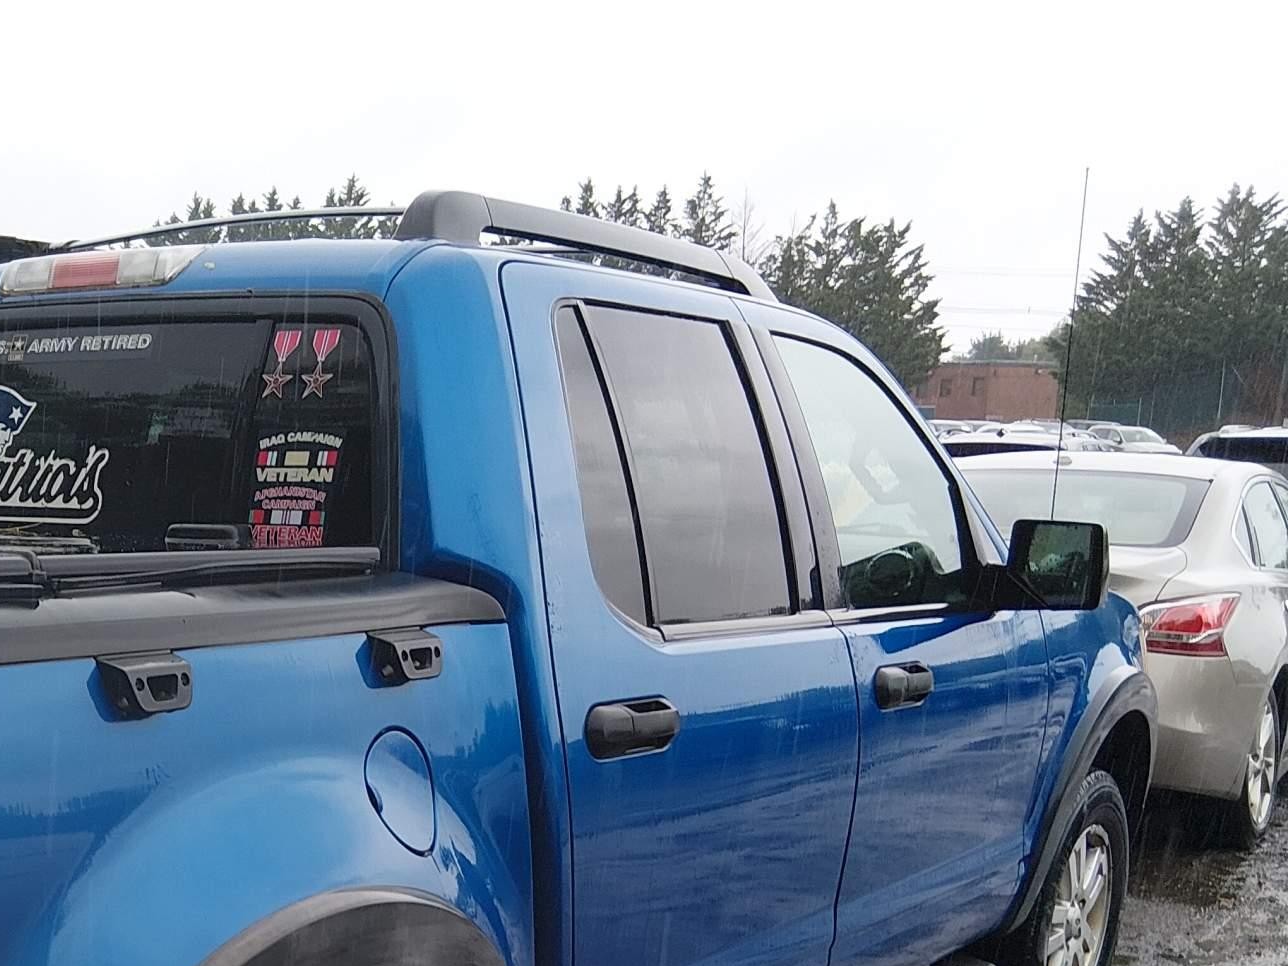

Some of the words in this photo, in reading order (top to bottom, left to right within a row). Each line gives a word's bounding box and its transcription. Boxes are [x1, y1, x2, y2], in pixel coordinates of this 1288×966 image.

[27, 337, 79, 353] ARMY
[79, 333, 152, 351] RETIRED
[259, 433, 285, 449] IRAQ
[287, 431, 343, 448] CAMPAIGN
[256, 467, 334, 482] VETERAN
[248, 524, 324, 541] VETERAN
